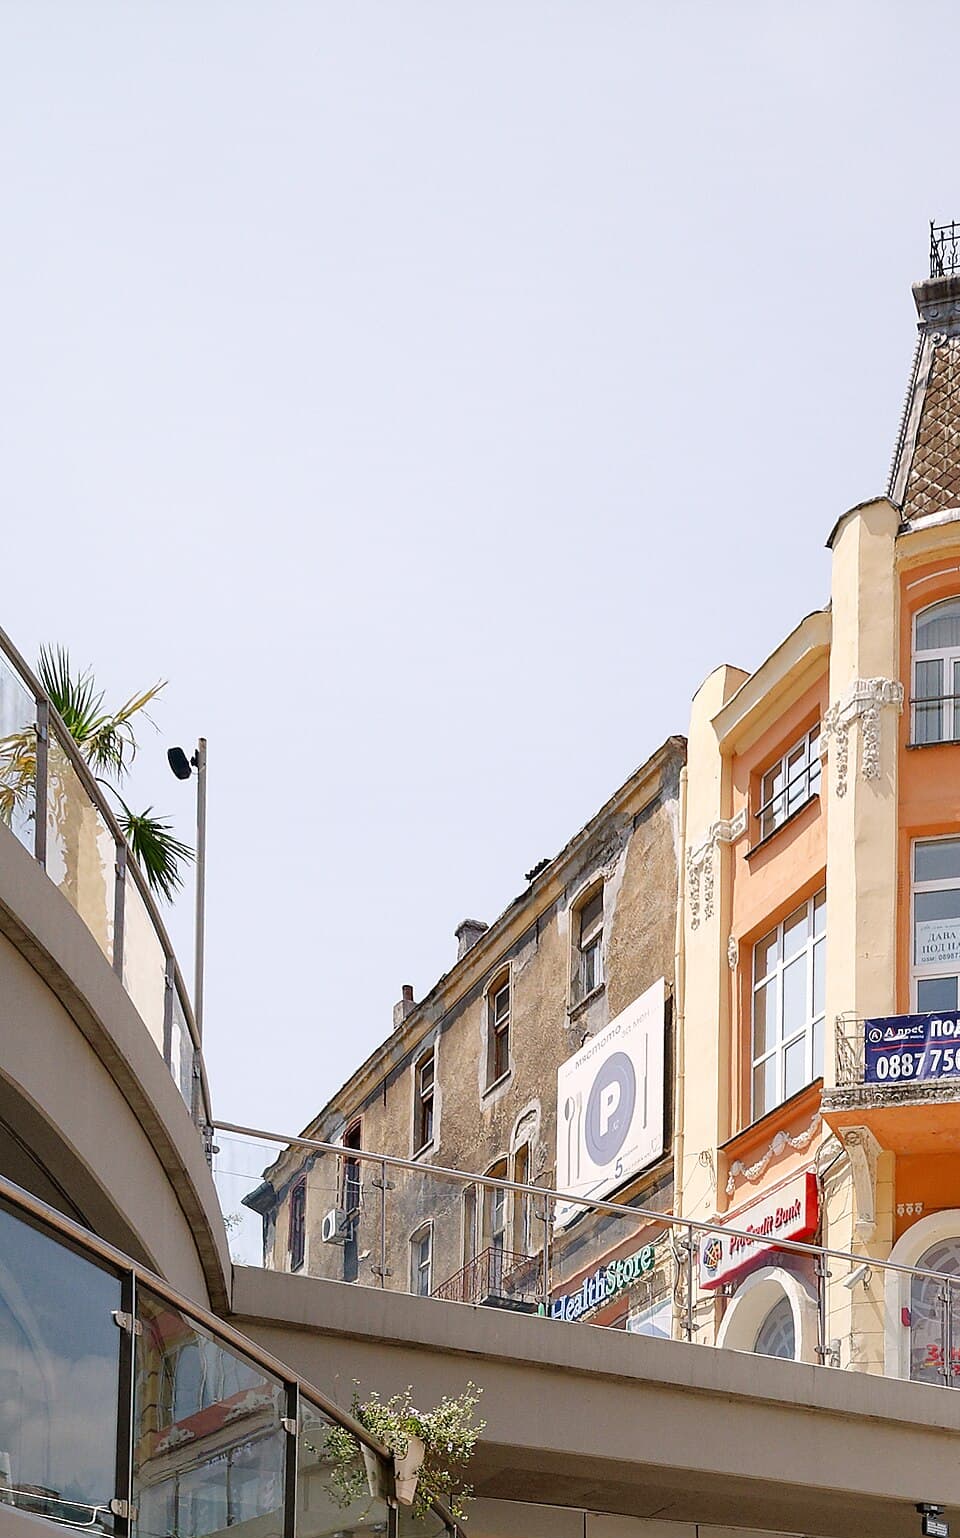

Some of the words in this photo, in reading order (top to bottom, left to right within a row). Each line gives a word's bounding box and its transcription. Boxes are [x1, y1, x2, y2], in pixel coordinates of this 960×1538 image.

[922, 943, 944, 954] ПОД
[928, 931, 956, 943] ДАВА
[876, 1053, 925, 1080] 0887
[615, 1157, 623, 1179] 5
[775, 1198, 801, 1229] Bank
[552, 1244, 655, 1321] HealthStore
